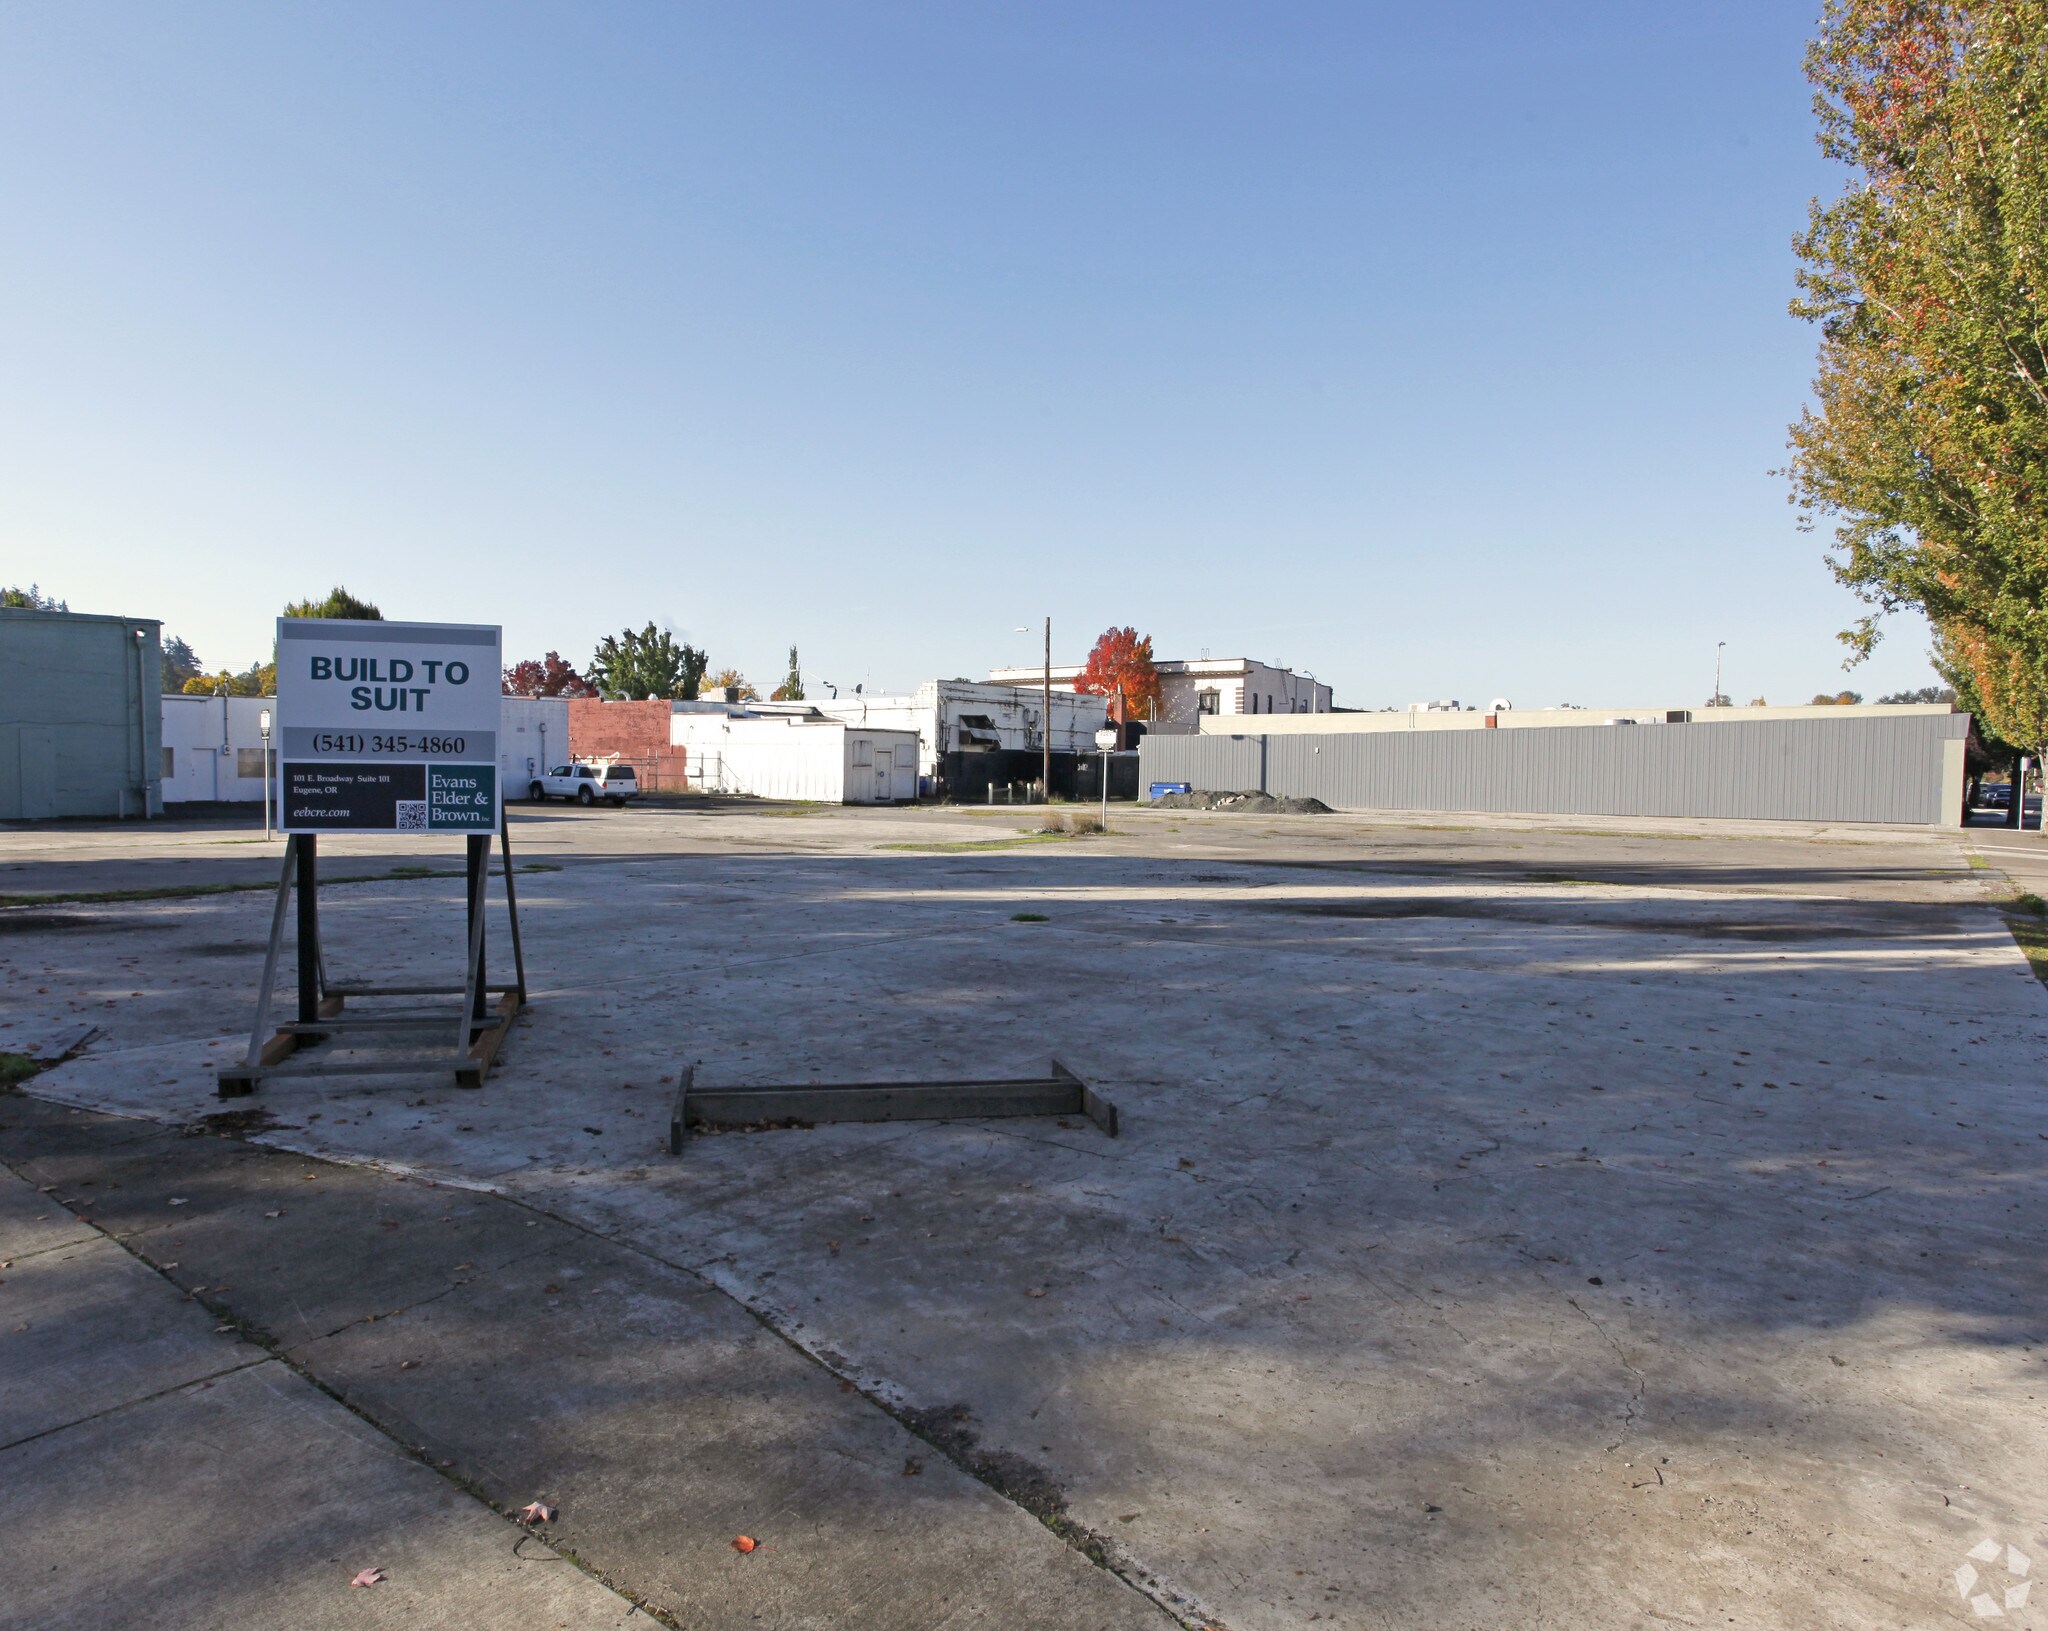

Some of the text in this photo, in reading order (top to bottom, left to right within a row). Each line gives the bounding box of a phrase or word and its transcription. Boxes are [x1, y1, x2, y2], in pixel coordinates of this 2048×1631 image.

[311, 656, 470, 685] BUILD TO
[350, 686, 431, 712] SUIT
[313, 733, 465, 754] (541) 345-4860
[293, 774, 390, 784] 101 E. Broadway Suite 101
[431, 774, 477, 789] Evans
[293, 786, 338, 795] Eugene, OR
[432, 791, 488, 805] Elder &
[293, 807, 350, 817] eebcre.com
[431, 807, 480, 822] Brown
